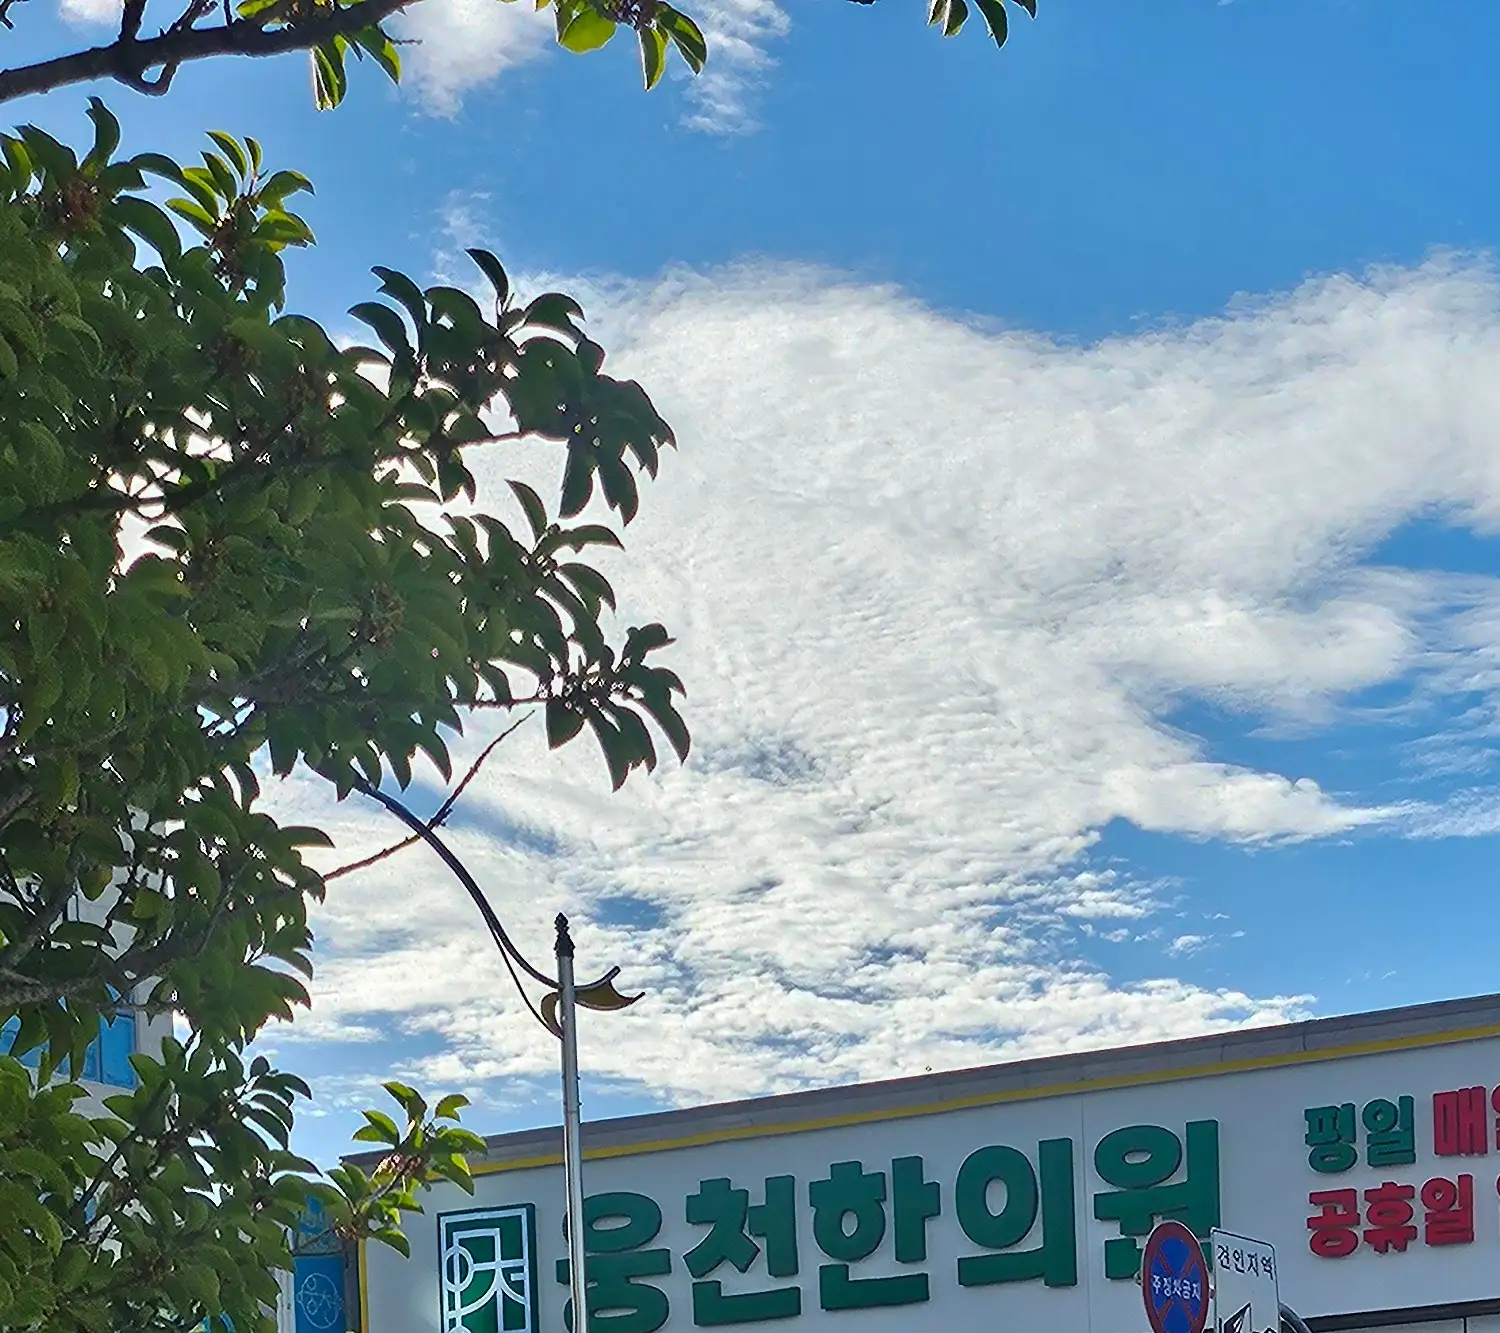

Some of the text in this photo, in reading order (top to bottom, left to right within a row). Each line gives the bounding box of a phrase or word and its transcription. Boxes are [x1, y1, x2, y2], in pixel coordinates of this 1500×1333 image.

[1304, 1095, 1417, 1174] 평일
[1307, 1174, 1475, 1258] 공휴일
[1152, 1273, 1200, 1302] 주정차금지
[1218, 1244, 1274, 1281] 견인지역
